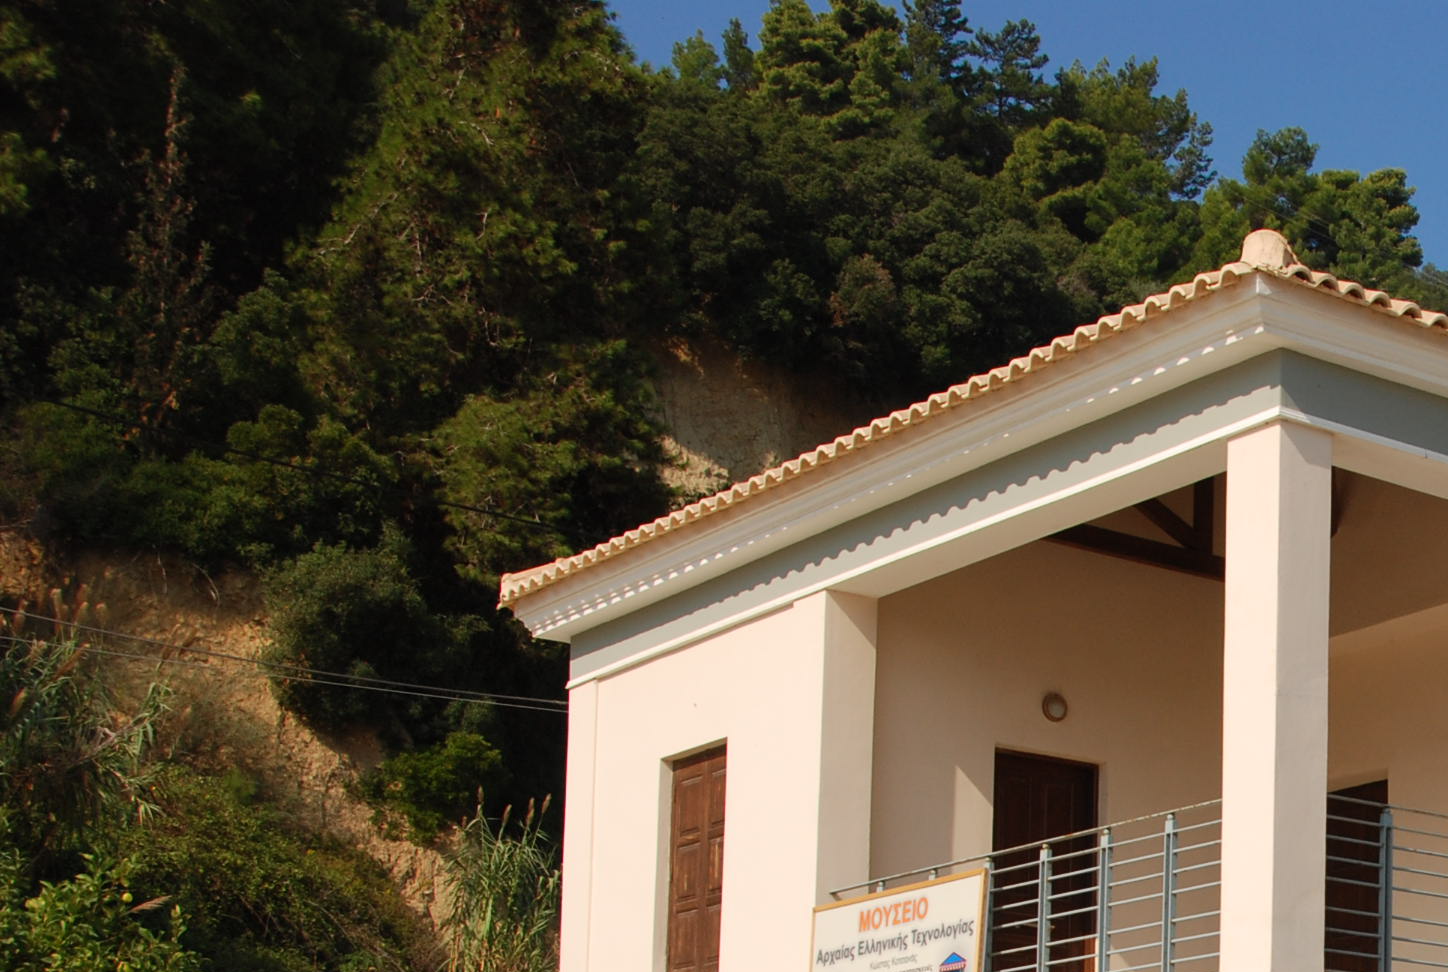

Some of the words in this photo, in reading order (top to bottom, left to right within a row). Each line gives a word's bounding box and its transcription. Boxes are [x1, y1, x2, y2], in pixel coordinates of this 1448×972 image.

[858, 896, 929, 933] ΜΟΥΣΕΙΟ
[816, 945, 856, 967] Αρχαίας
[858, 933, 909, 957] Ελληνικής
[911, 919, 974, 947] Τεχνολογίας
